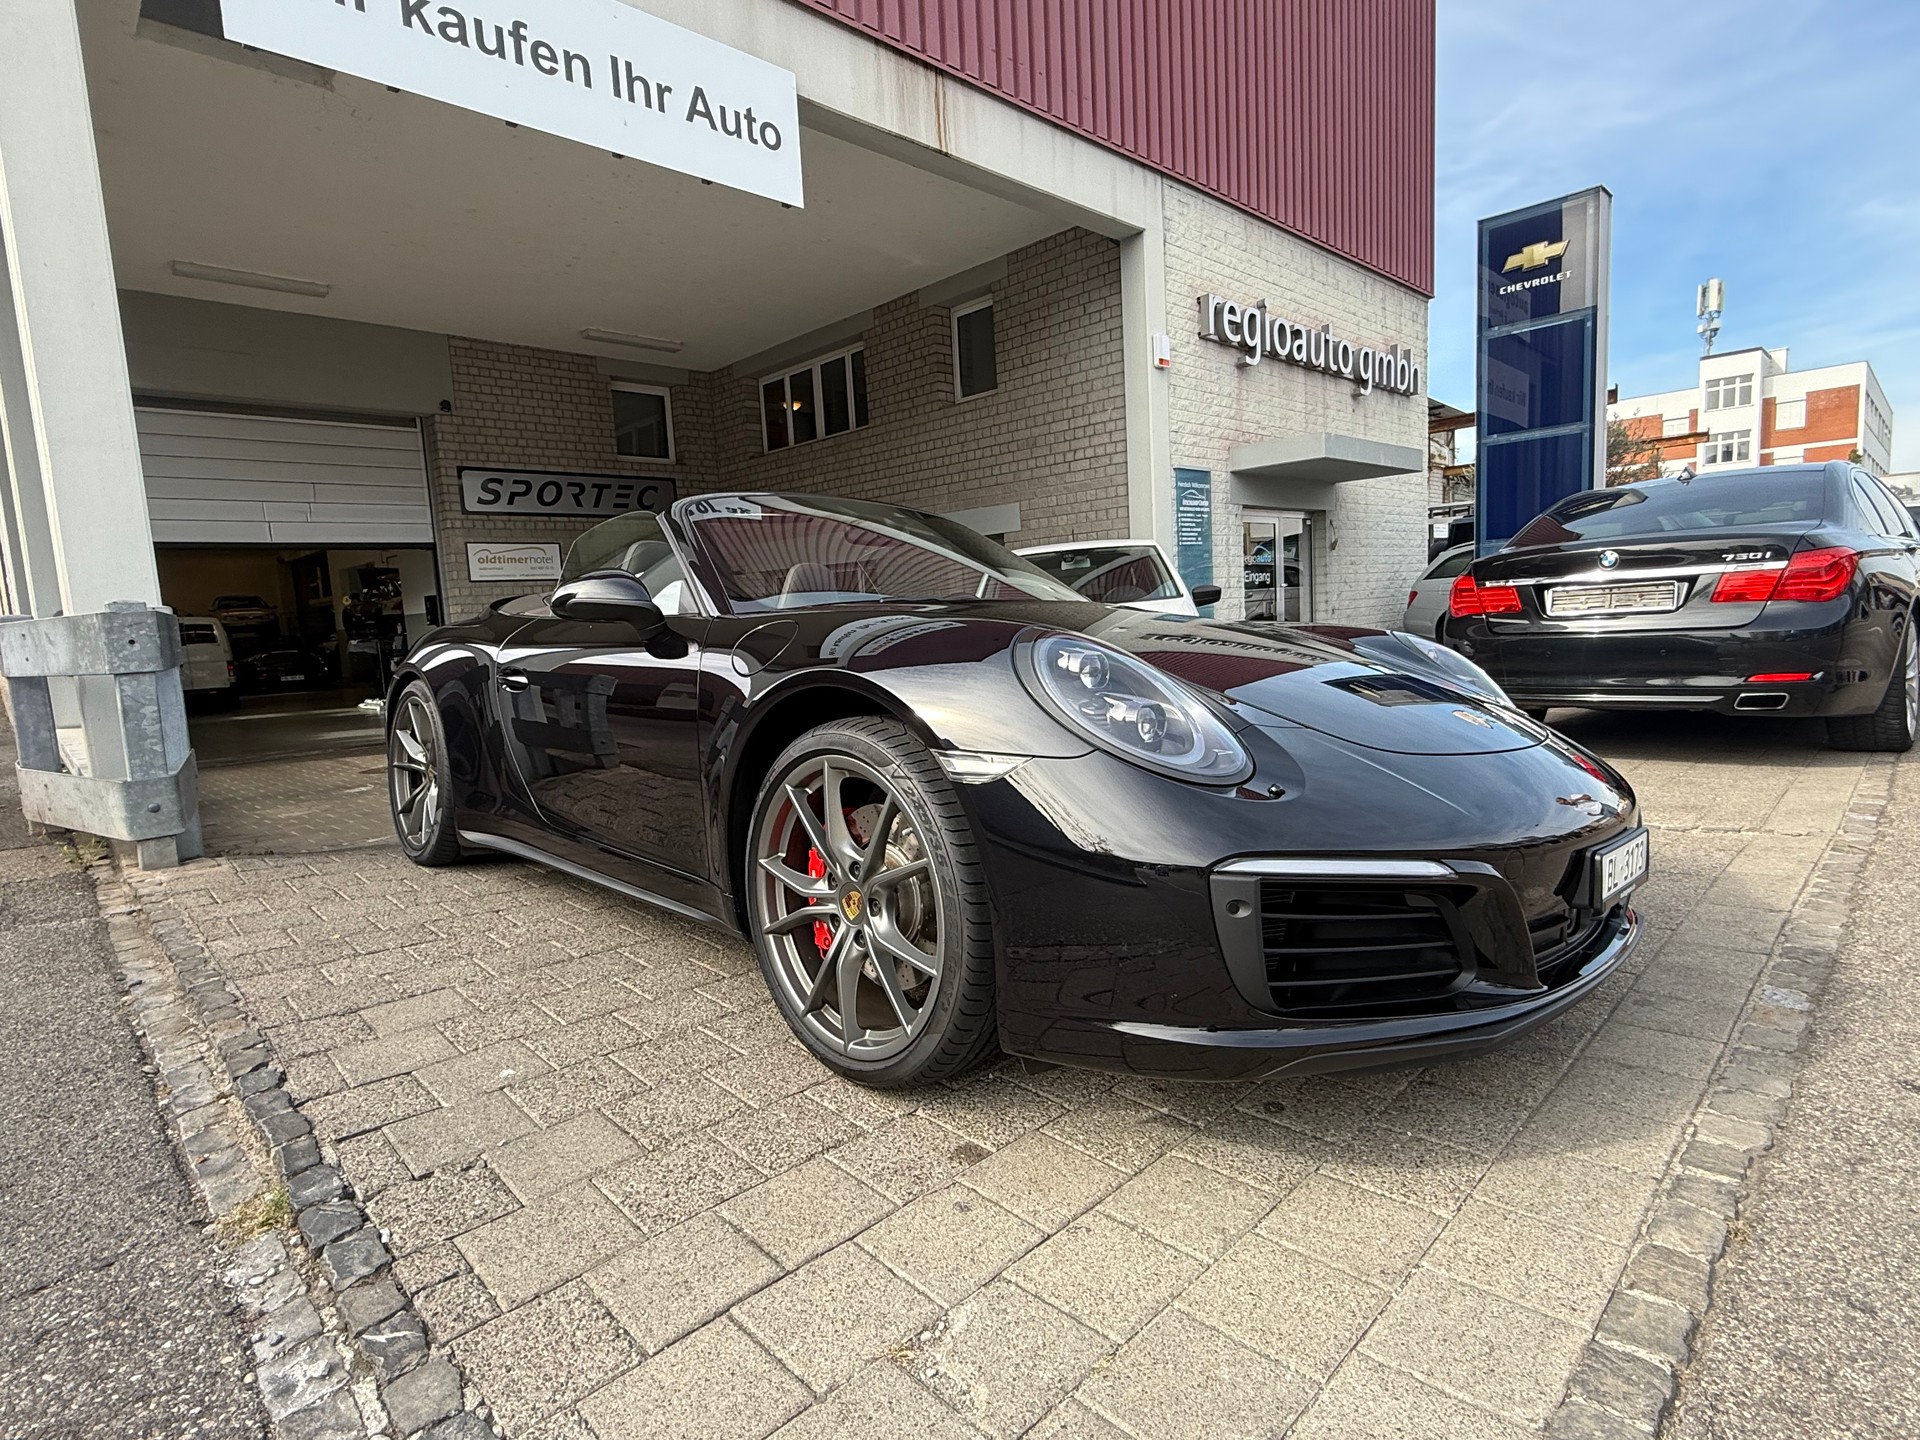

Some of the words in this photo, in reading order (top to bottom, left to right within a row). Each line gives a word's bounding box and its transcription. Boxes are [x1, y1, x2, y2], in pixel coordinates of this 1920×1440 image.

[401, 0, 592, 89] kaufen
[610, 54, 672, 114] Ihr
[685, 86, 782, 151] Auto
[1500, 270, 1572, 294] CHEVROLET
[1201, 293, 1352, 374] regioauto
[1354, 344, 1421, 396] gmbh
[476, 478, 659, 510] SPORTEC
[477, 554, 554, 565] oldtimerhotel
[1244, 555, 1271, 565] egioauto
[1244, 570, 1271, 584] Eingang
